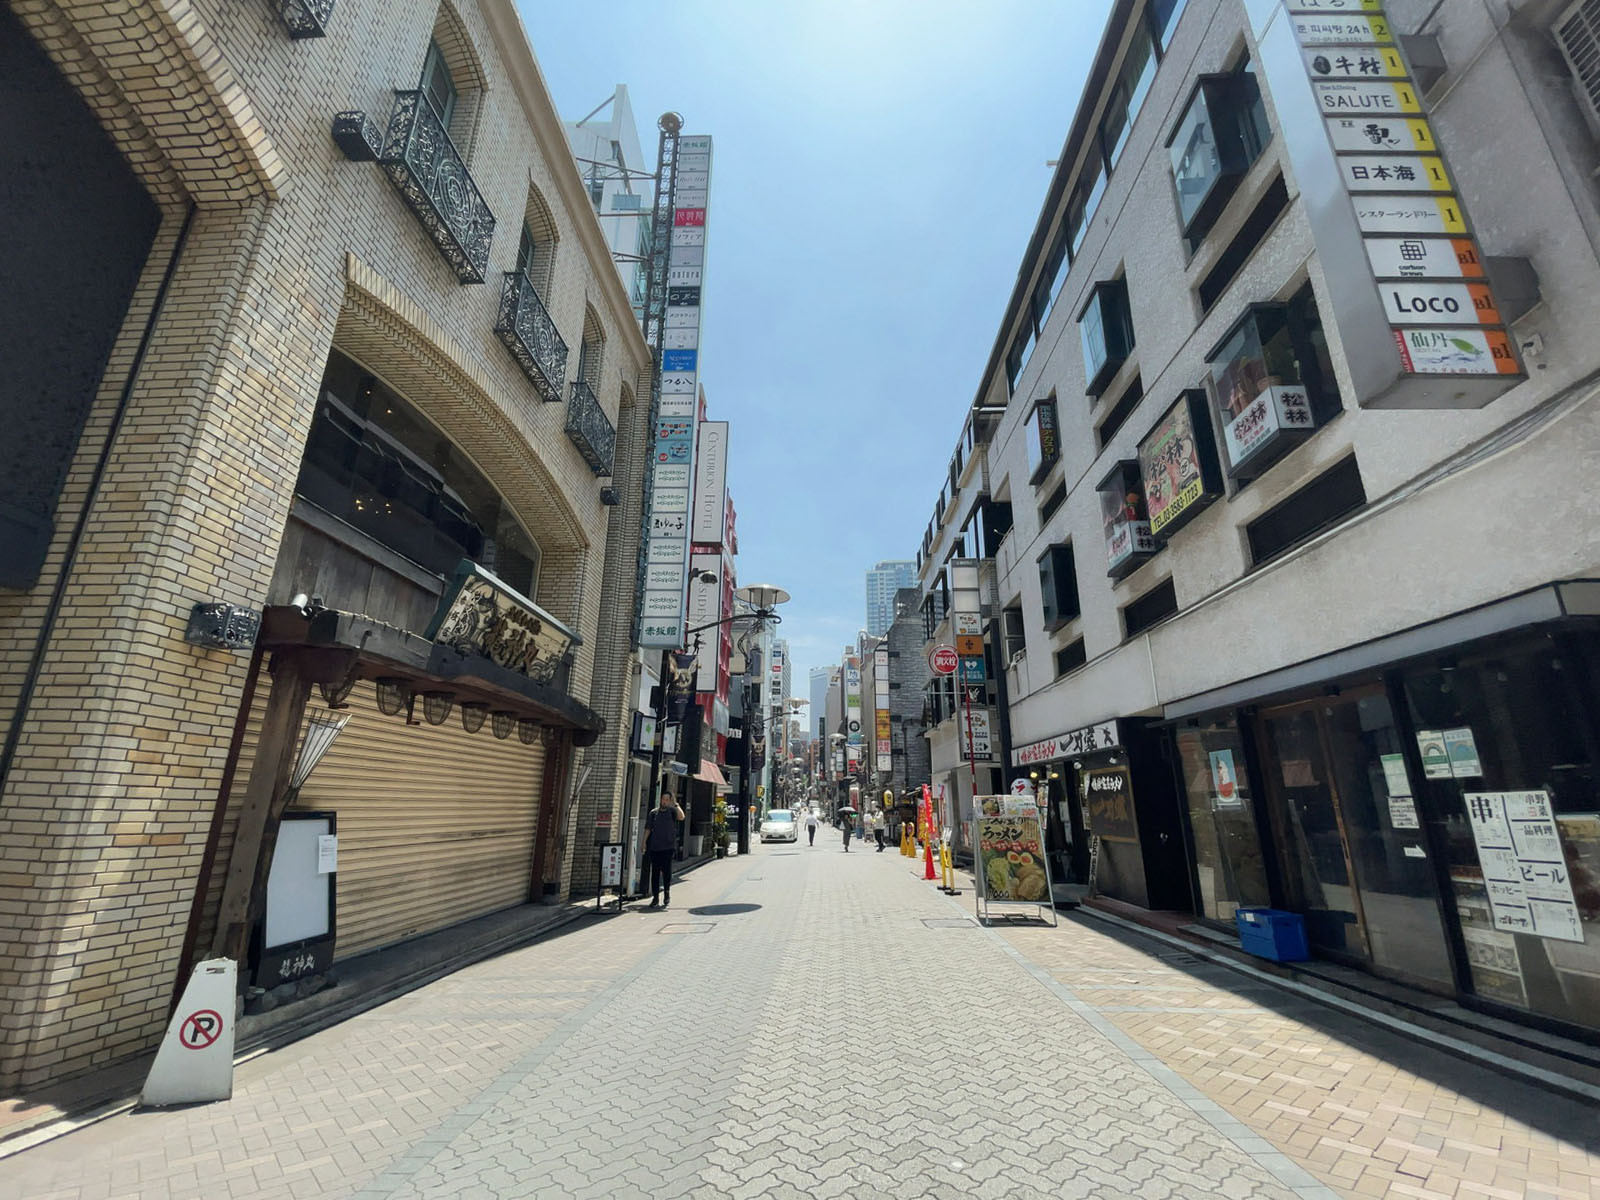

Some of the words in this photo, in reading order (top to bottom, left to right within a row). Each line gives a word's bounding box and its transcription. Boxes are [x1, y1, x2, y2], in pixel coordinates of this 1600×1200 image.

[1377, 25, 1388, 35] 2
[1389, 56, 1397, 67] 1
[1324, 95, 1395, 108] SALUTE
[1402, 92, 1411, 104] 1
[1416, 128, 1426, 141] 1
[1351, 165, 1416, 181] 日本海
[1430, 167, 1442, 181] 1
[1446, 208, 1457, 222] 1
[1457, 250, 1478, 265] B1
[1474, 294, 1495, 311] B1
[1492, 343, 1512, 360] B1
[645, 626, 678, 636] 赤坂館
[1470, 795, 1495, 824] 串
[1520, 864, 1566, 884] ビール
